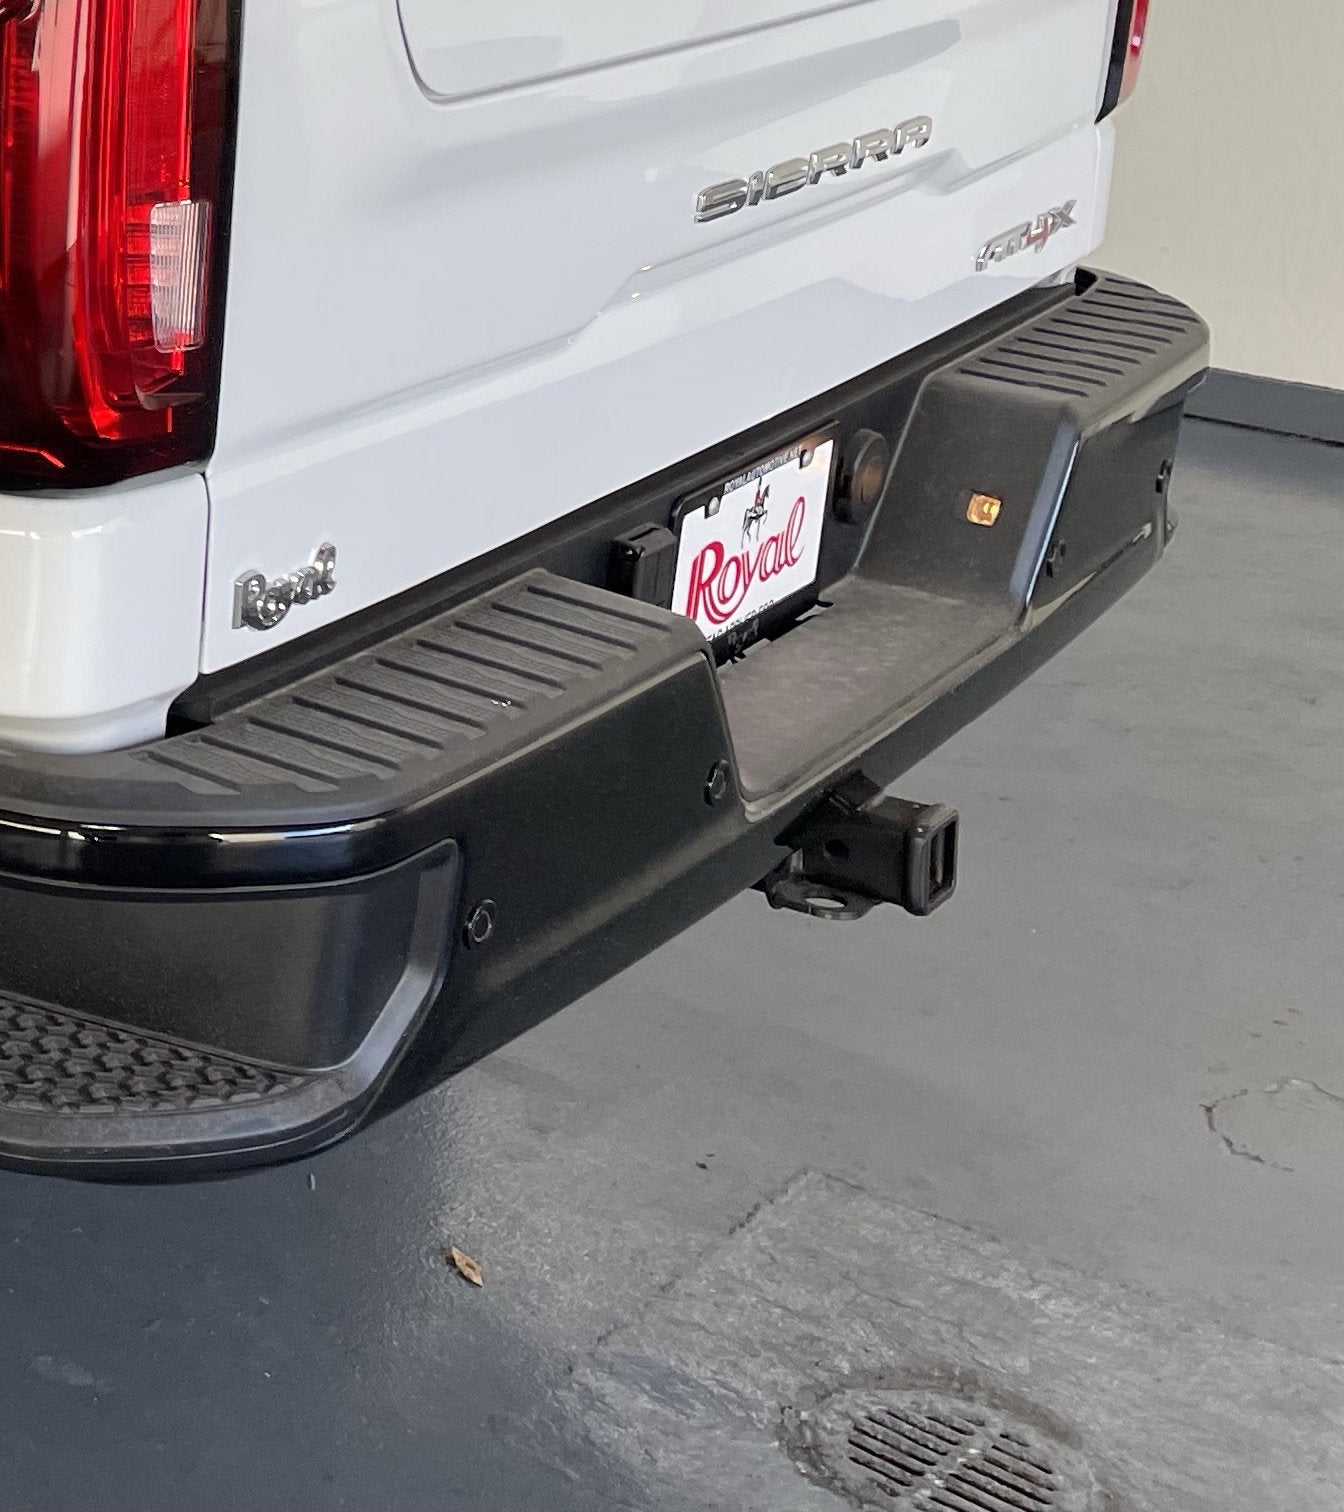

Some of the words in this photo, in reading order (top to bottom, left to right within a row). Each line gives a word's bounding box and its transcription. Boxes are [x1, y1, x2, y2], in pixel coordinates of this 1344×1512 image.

[694, 115, 932, 223] SIERRA
[975, 199, 1077, 272] AT4X
[232, 542, 337, 630] Royal
[686, 497, 805, 625] Royal
